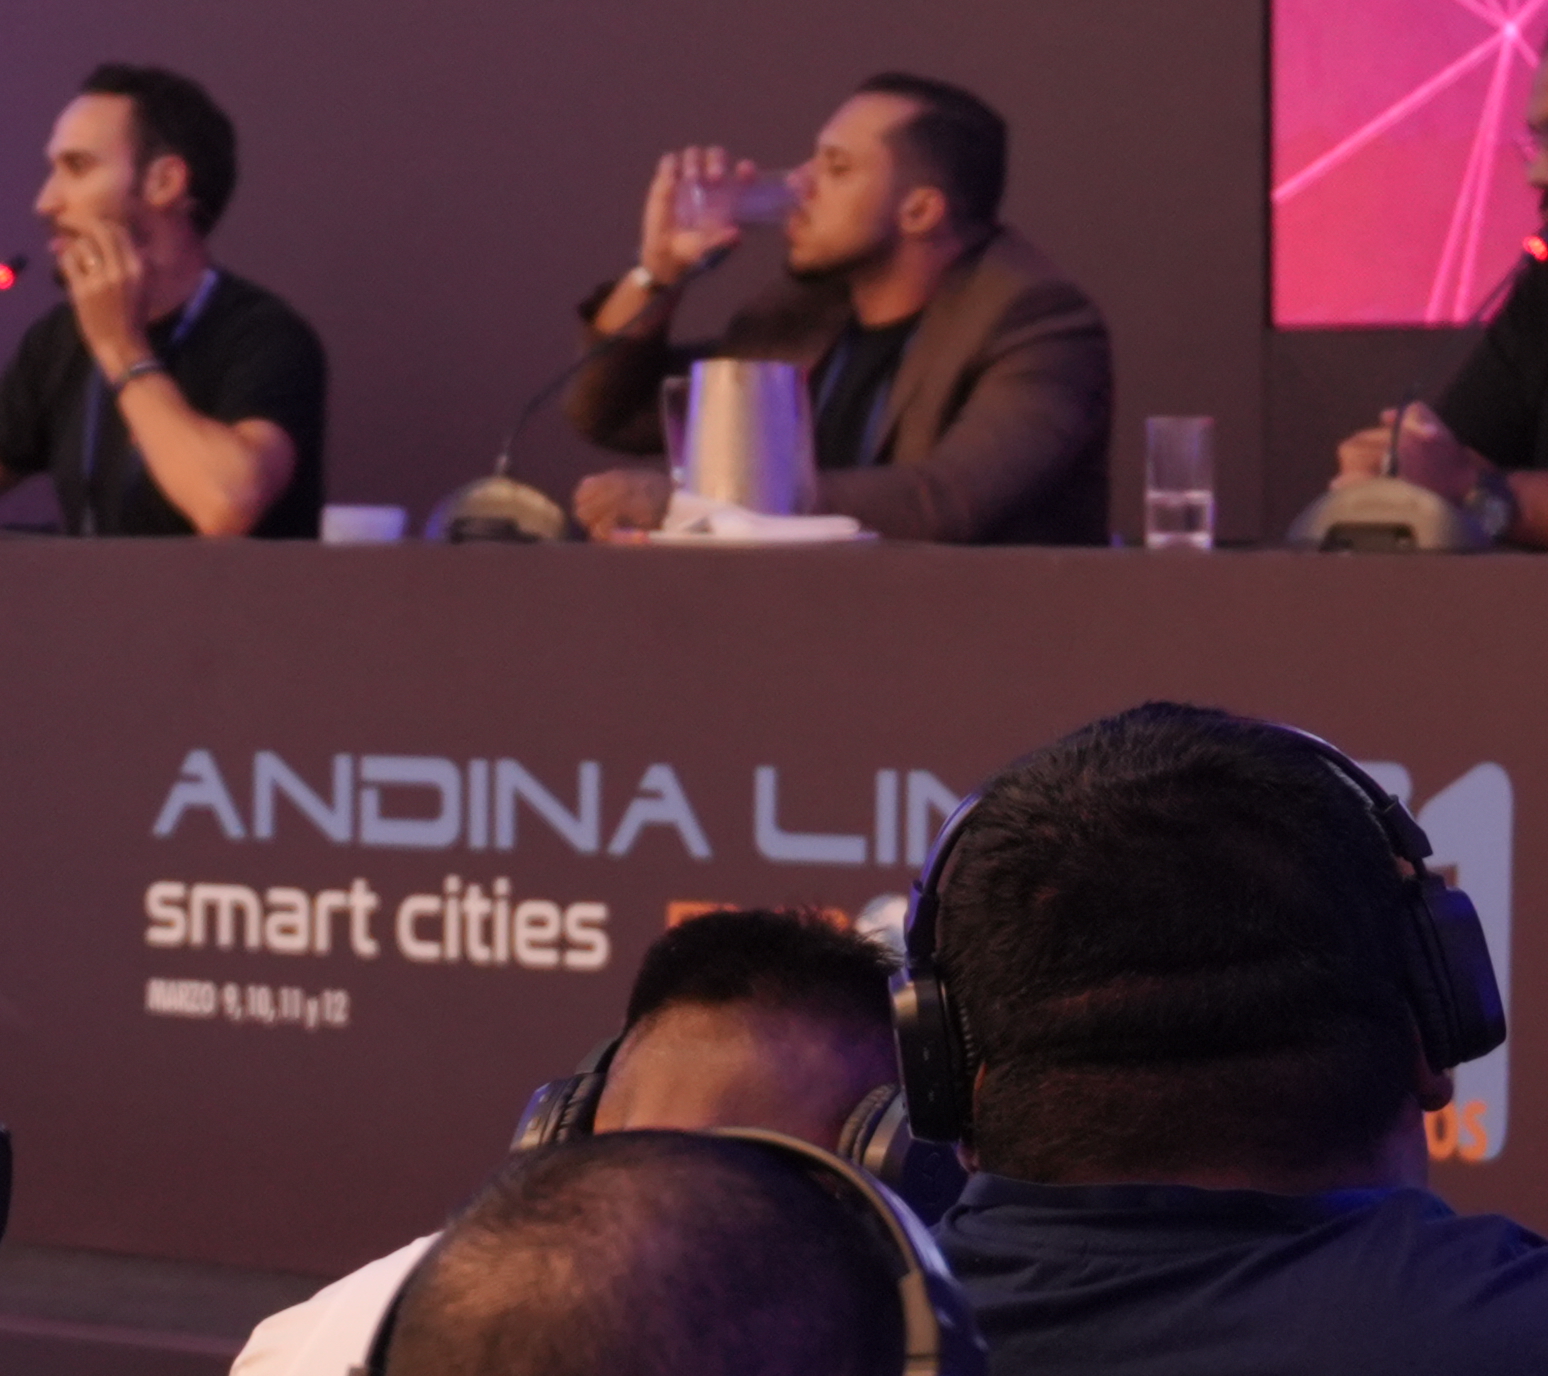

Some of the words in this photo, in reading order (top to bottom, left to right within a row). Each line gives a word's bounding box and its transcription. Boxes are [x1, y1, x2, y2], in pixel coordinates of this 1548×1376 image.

[152, 748, 712, 860] ANDINA
[144, 877, 381, 959] smart
[395, 874, 611, 971] cities
